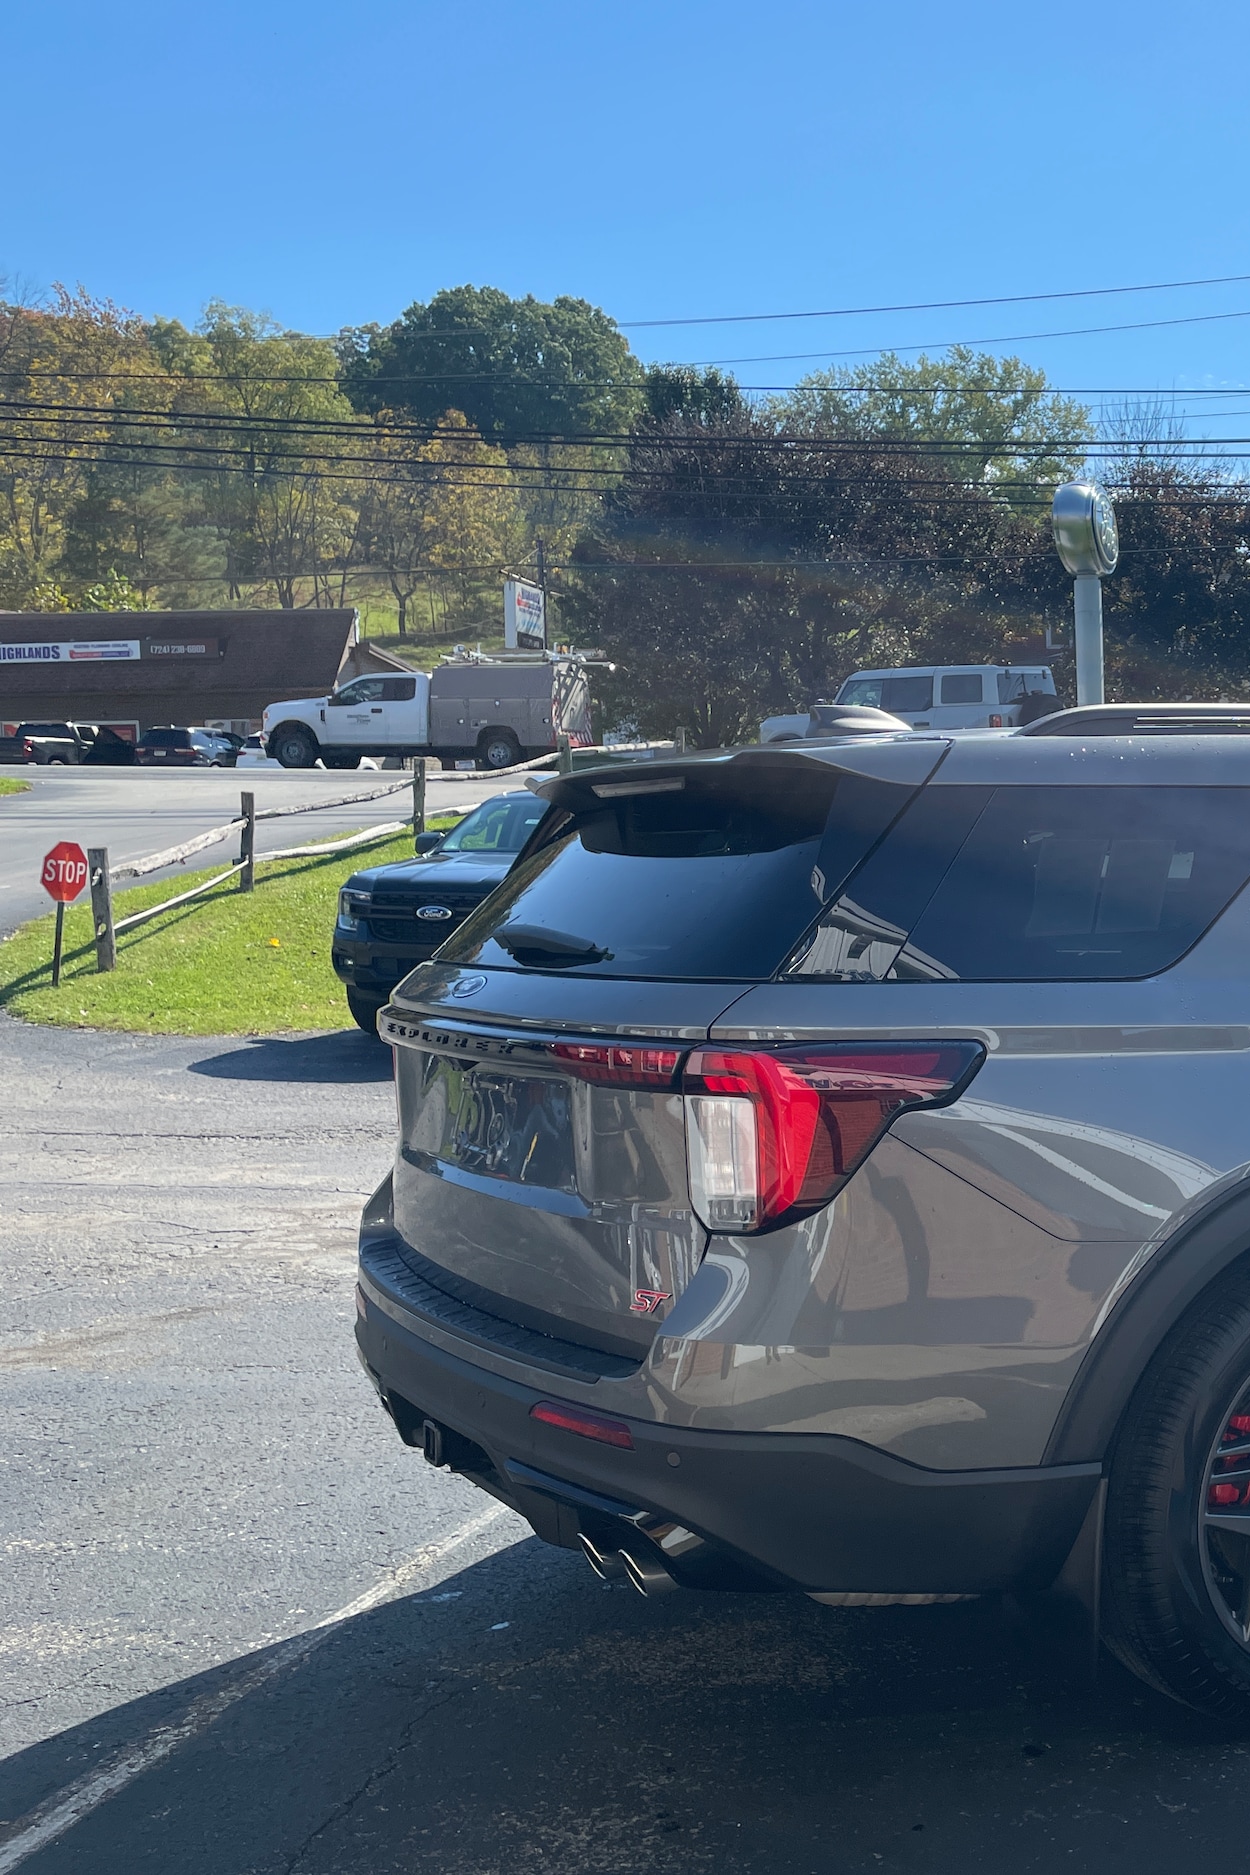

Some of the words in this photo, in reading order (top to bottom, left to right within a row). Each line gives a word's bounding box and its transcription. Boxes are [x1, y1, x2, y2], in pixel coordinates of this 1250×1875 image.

[150, 645, 170, 654] (724)
[44, 859, 86, 884] STOP
[387, 1022, 516, 1054] EXPLORER
[630, 1289, 672, 1313] ST
